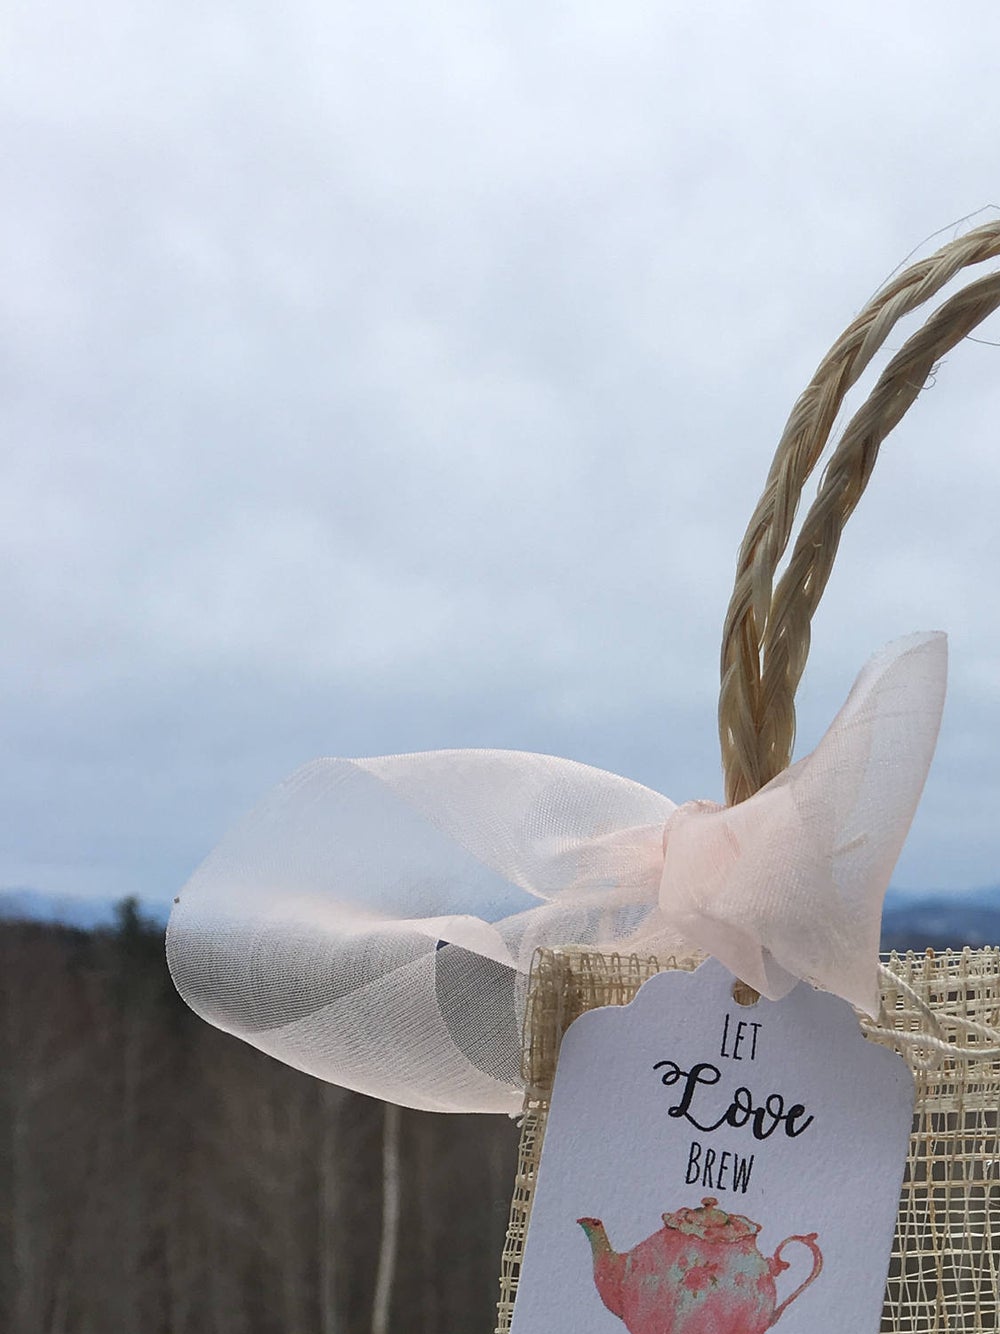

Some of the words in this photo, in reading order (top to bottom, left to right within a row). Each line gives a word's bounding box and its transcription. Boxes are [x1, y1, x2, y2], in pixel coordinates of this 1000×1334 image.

[720, 1013, 763, 1061] LET
[652, 1060, 815, 1141] Love
[685, 1141, 755, 1194] BREW
